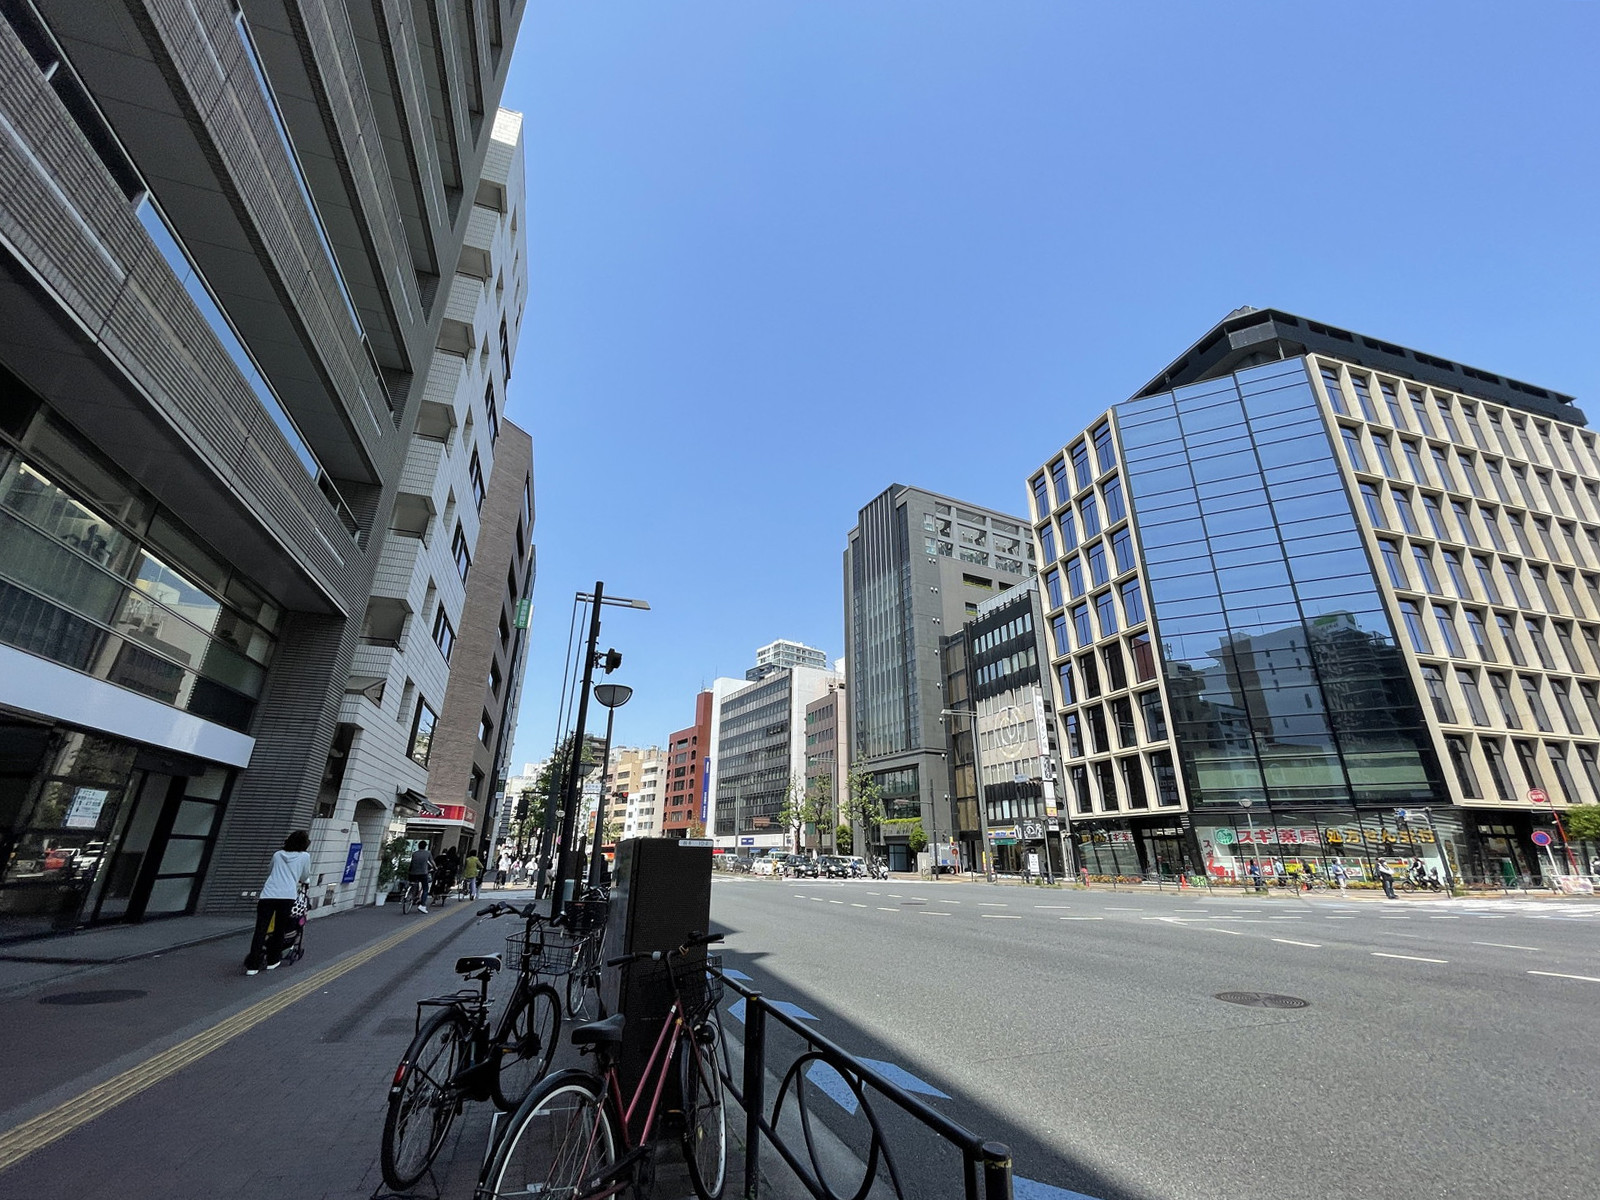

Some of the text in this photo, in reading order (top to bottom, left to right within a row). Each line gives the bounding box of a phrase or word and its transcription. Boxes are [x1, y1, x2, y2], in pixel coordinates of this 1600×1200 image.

[1237, 828, 1320, 844] スギ薬局
[1326, 827, 1435, 843] 処方せん受付
